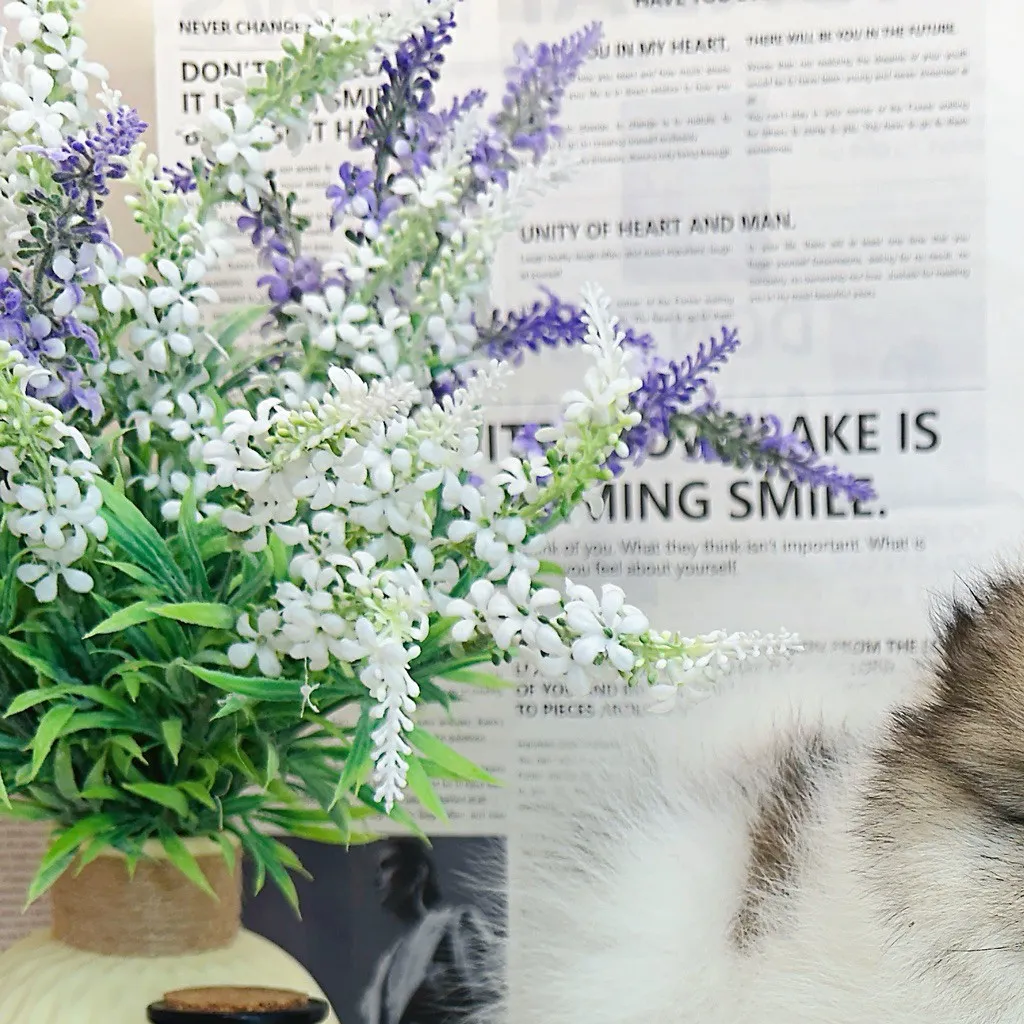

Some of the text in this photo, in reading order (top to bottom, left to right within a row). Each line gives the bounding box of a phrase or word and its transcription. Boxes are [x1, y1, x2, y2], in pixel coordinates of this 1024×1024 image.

[179, 19, 231, 35] NEVER
[615, 40, 635, 58] IN
[639, 38, 666, 57] MY
[519, 211, 797, 245] UNITY OF HEART AND MAN.
[899, 411, 939, 452] IS
[666, 539, 699, 557] they
